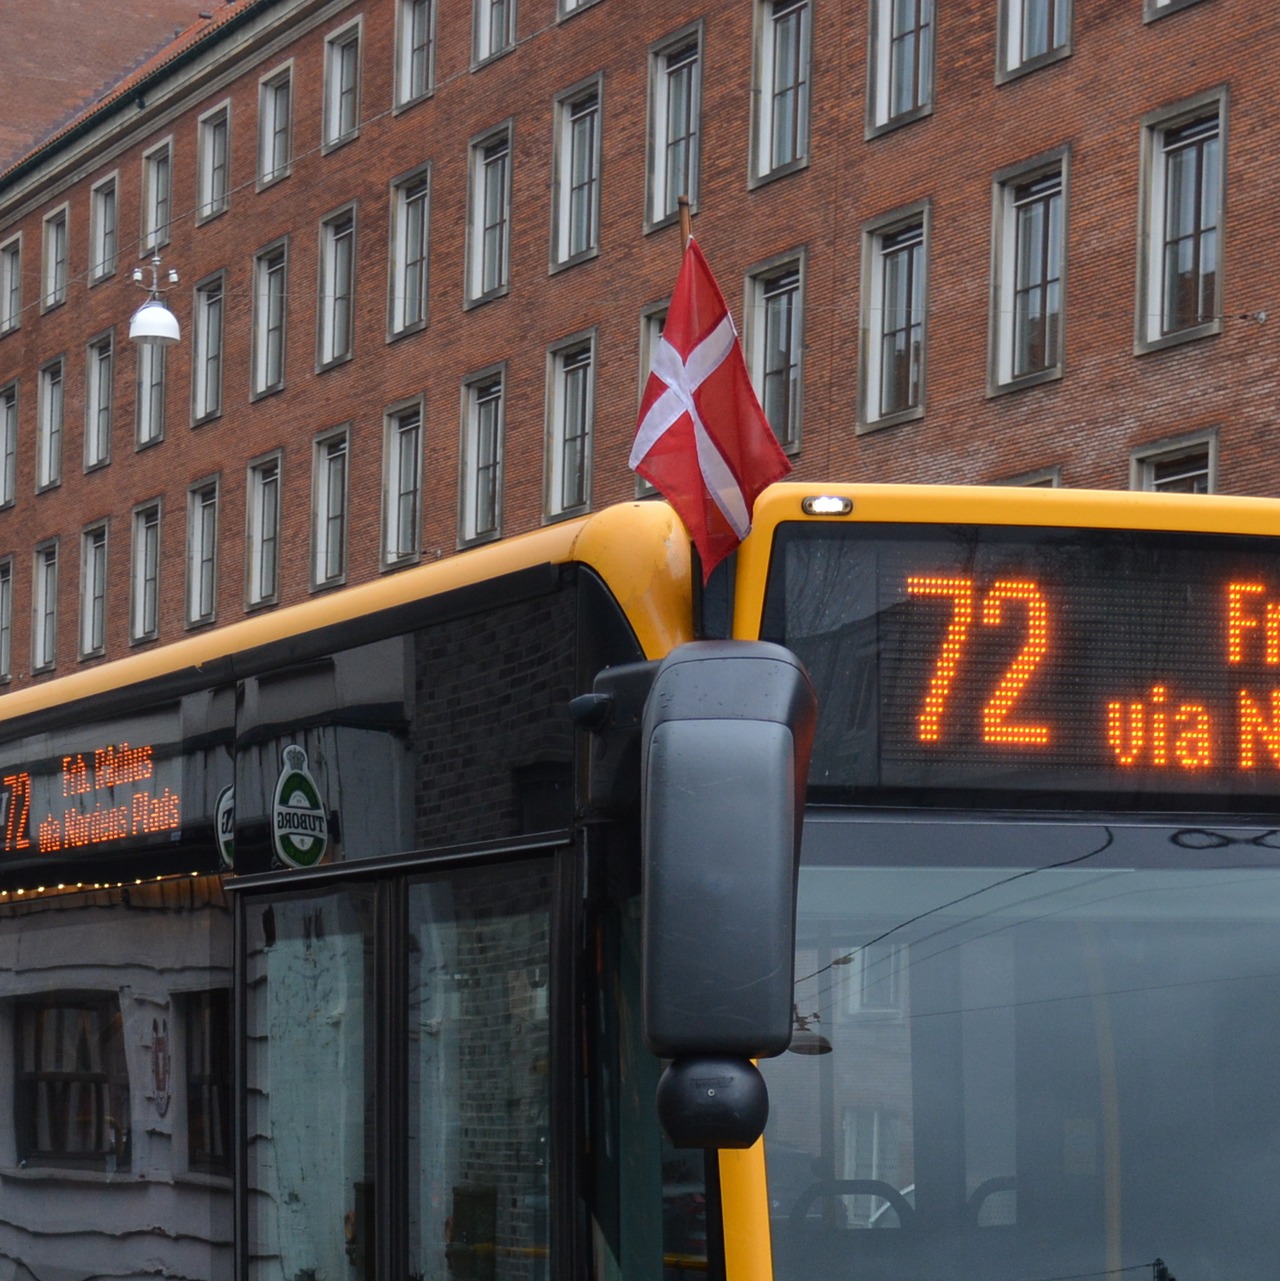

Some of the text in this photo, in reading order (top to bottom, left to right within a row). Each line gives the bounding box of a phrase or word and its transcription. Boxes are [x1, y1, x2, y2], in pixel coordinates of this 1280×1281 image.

[907, 577, 1048, 743] 72
[1108, 686, 1210, 766] via
[3, 772, 32, 852] 72
